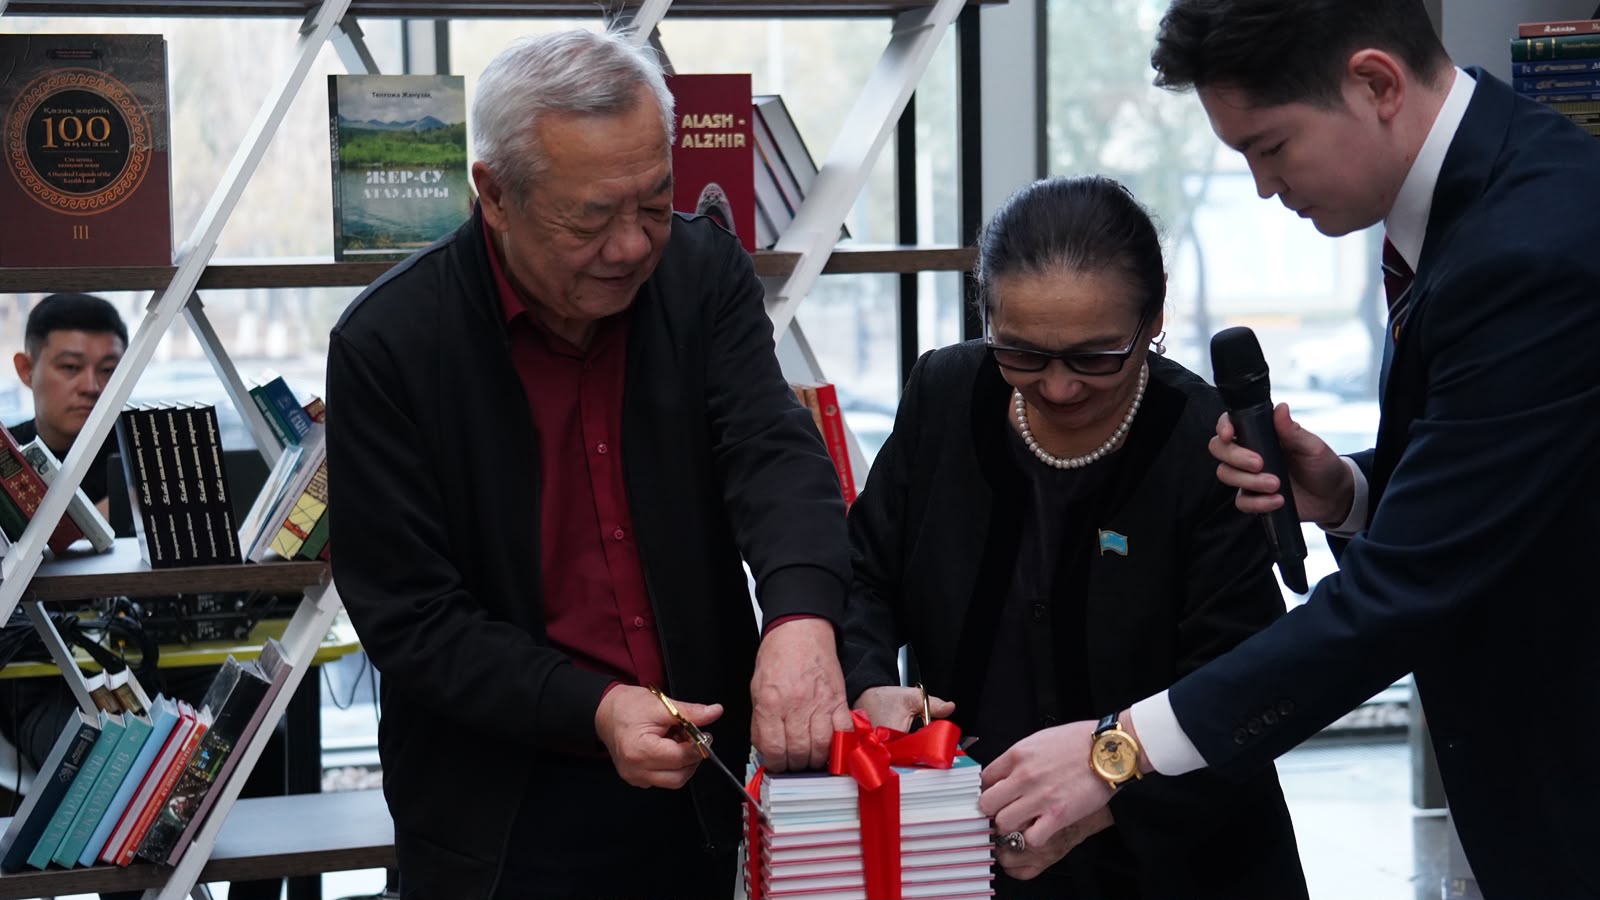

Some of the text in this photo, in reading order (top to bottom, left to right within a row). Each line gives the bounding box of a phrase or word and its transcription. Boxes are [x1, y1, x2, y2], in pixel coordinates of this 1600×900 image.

[681, 114, 734, 128] ALASH
[41, 116, 111, 148] 100
[681, 133, 746, 148] ALZHIR
[366, 170, 444, 184] ЖЕР-СУ
[362, 188, 448, 200] АТАУЛАРЫ
